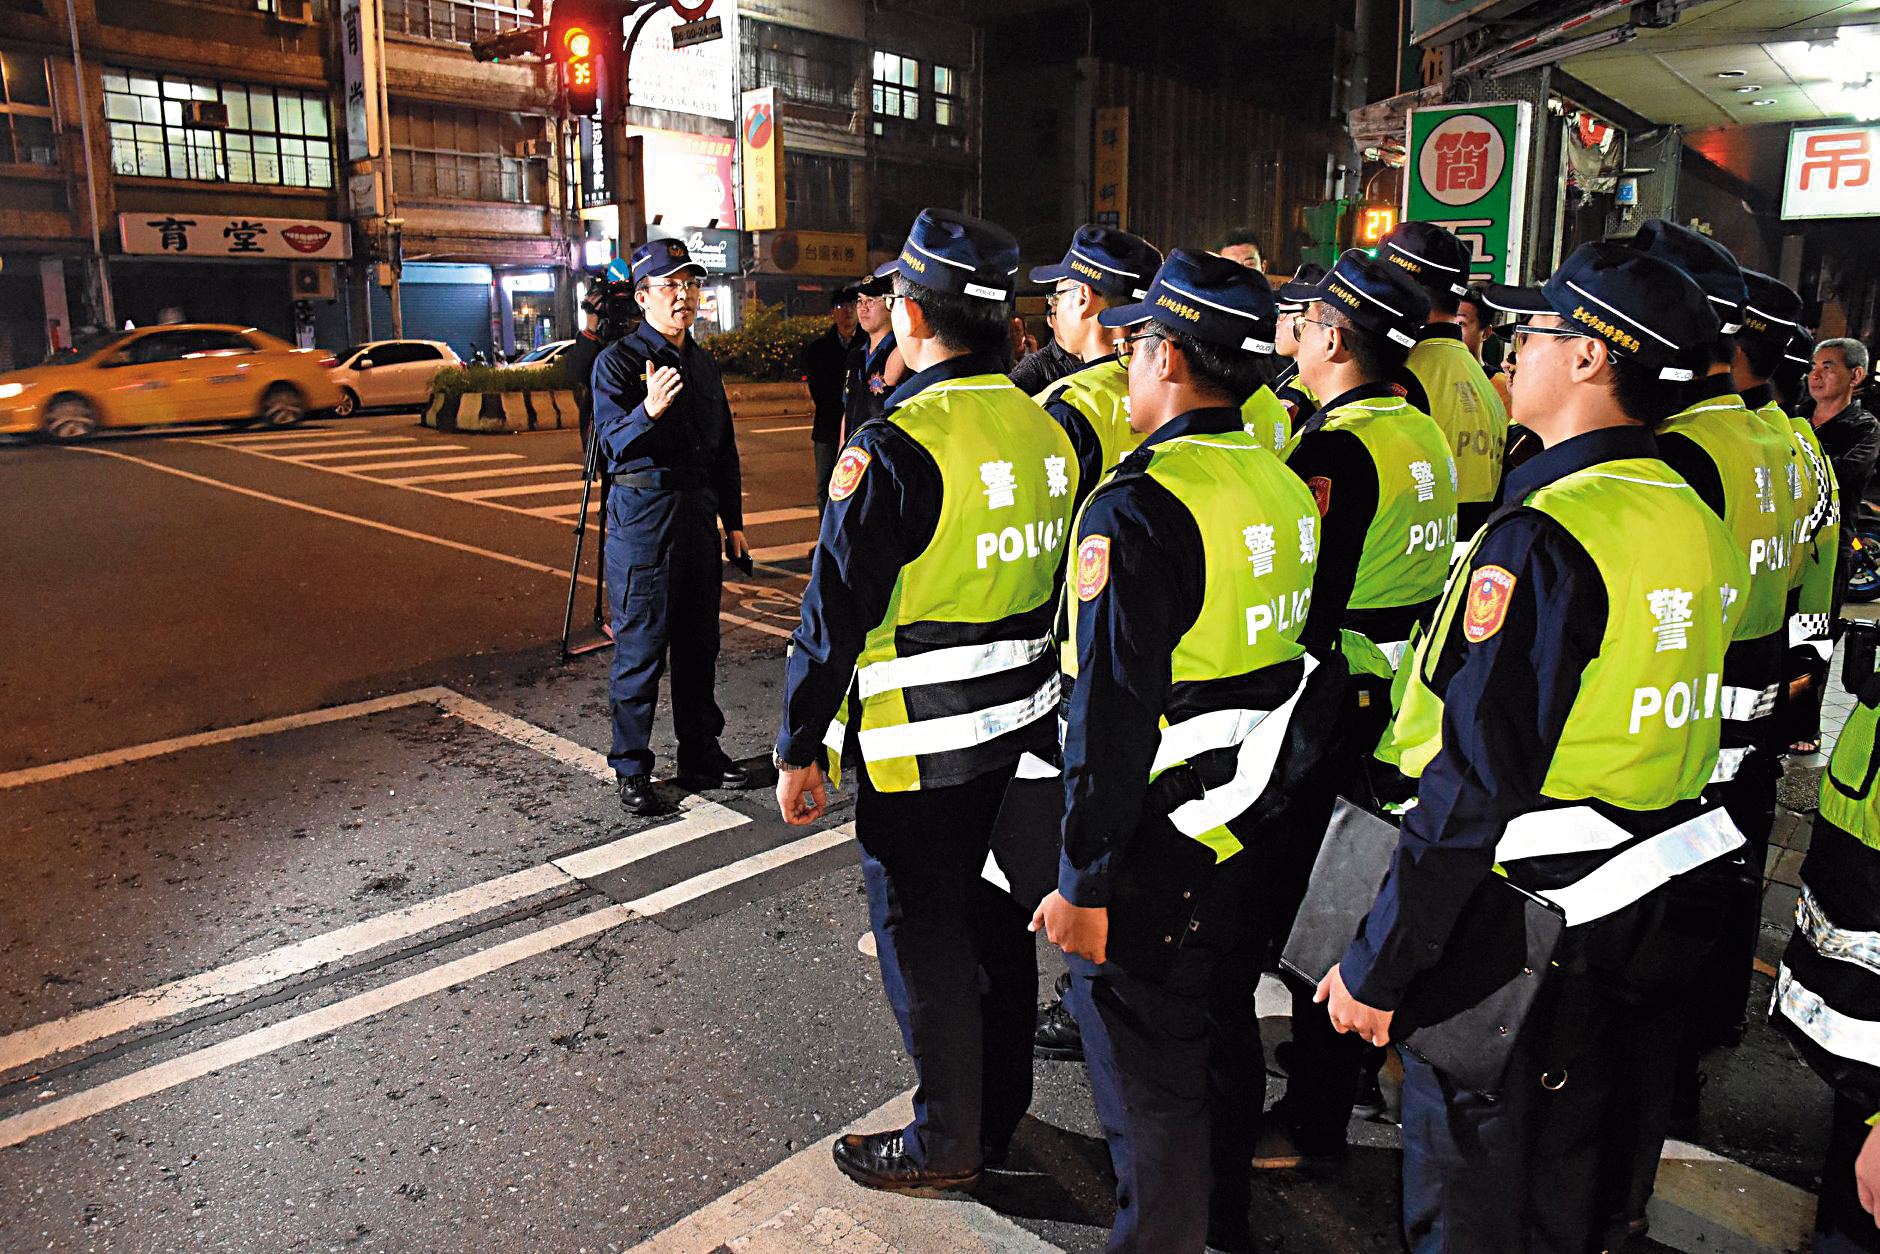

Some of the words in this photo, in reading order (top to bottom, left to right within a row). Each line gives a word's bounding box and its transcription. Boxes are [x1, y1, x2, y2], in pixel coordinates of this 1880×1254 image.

[674, 22, 722, 42] 06:00-24:00
[1435, 131, 1491, 192] 簡
[1799, 131, 1871, 191] 吊
[146, 216, 268, 253] 育堂
[1366, 210, 1393, 239] 27
[979, 454, 1068, 511] 警察
[1241, 514, 1316, 578] 警察
